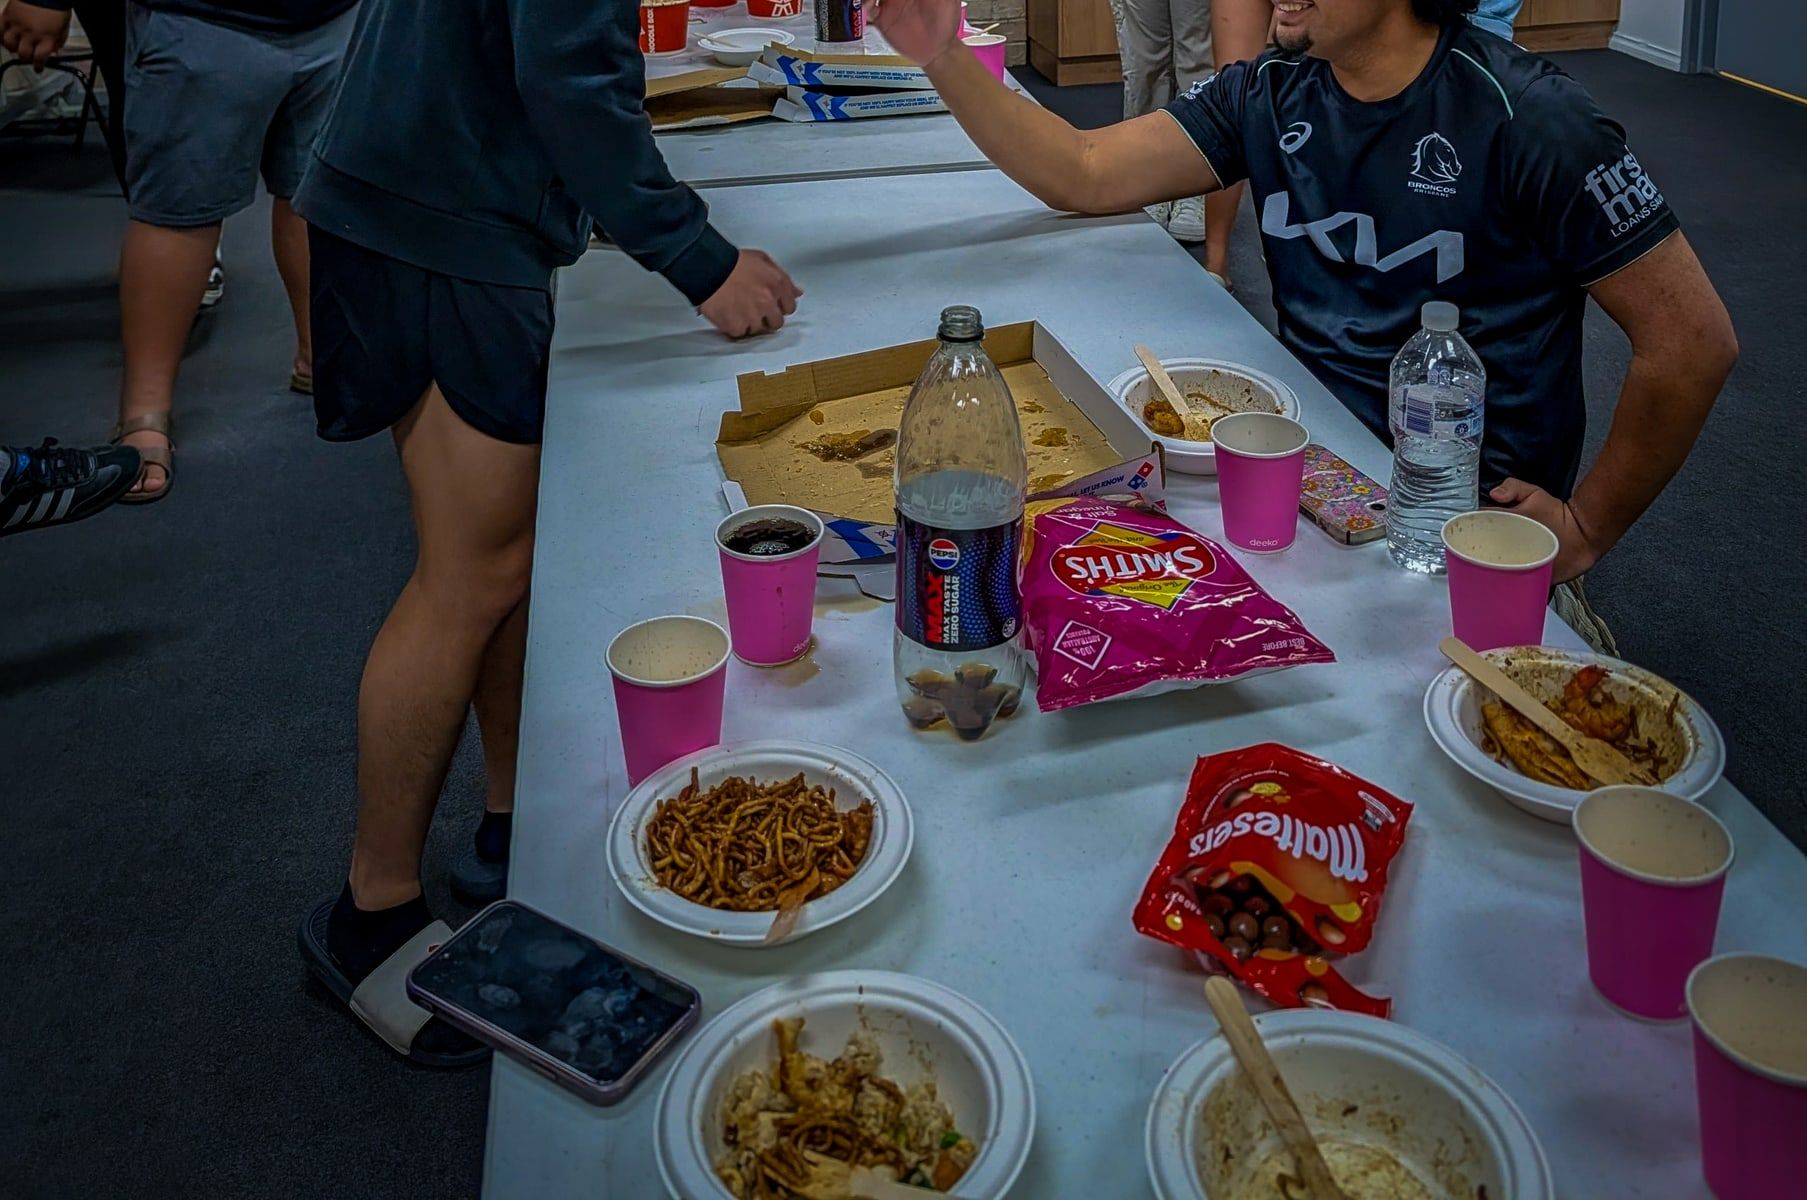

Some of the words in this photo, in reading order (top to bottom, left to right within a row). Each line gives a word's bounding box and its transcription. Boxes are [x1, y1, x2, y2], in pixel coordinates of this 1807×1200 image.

[1584, 145, 1641, 204] firs
[1408, 181, 1457, 194] BRONCOS
[1602, 172, 1658, 225] ma
[1080, 486, 1090, 494] LET
[1101, 475, 1124, 486] KNOW
[930, 549, 958, 559] PEPSI
[1249, 539, 1279, 547] deeko
[1065, 546, 1204, 584] SMITH'S
[951, 575, 960, 613] SUGAR
[926, 571, 944, 643] MAX
[943, 616, 951, 644] MAX
[951, 616, 960, 644] ZERO
[1072, 645, 1096, 657] 100%
[1262, 640, 1288, 651] BEFORE
[1288, 638, 1305, 647] BEST
